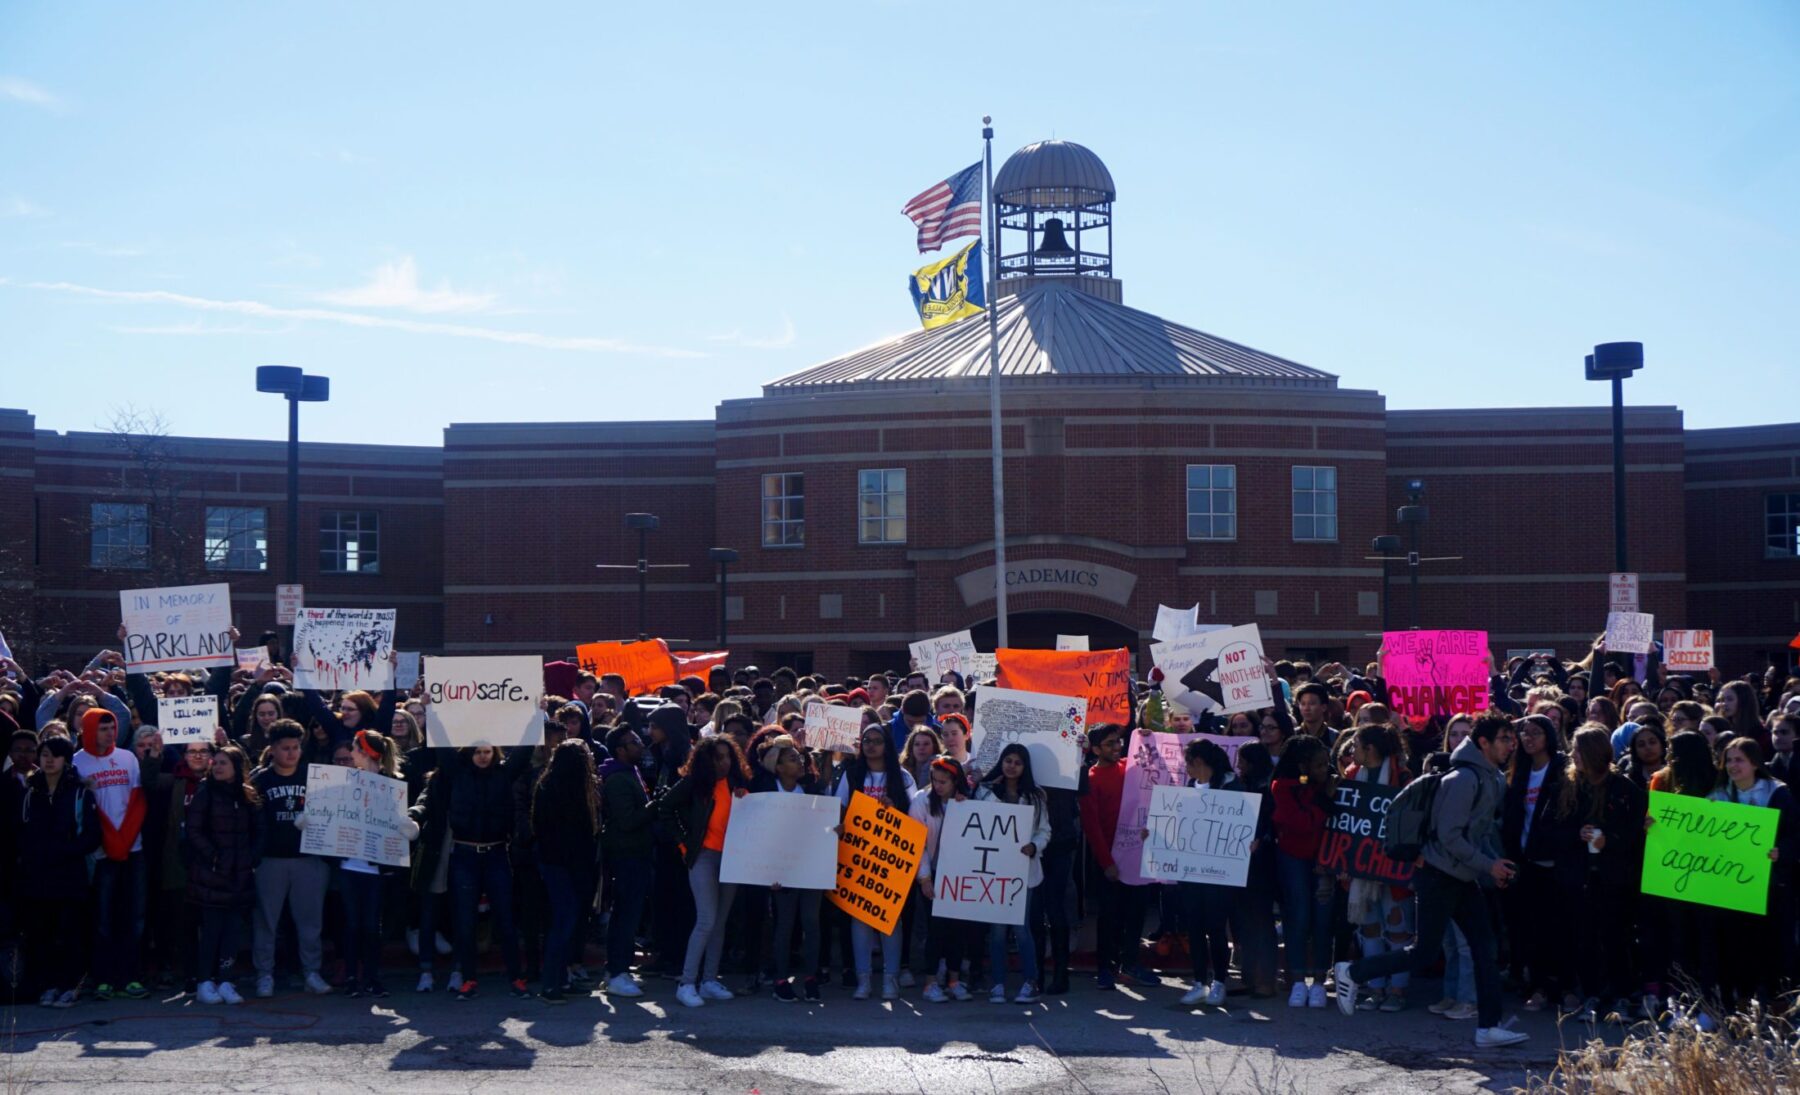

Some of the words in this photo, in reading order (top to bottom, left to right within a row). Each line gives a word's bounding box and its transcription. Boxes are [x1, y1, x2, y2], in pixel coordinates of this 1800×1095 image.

[993, 568, 1098, 588] CADEMICS
[134, 596, 149, 611] IN
[159, 593, 215, 609] MEMORY
[166, 614, 183, 625] OF
[127, 631, 232, 662] PARKLAND
[1386, 633, 1418, 657] WE
[1436, 631, 1480, 656] ARE
[1225, 649, 1247, 665] NOT
[1083, 668, 1129, 687] VICTIMS
[1220, 664, 1263, 686] ANOTHER
[430, 678, 530, 704] g(un)safe.
[1076, 690, 1130, 713] HANGE
[1231, 686, 1253, 701] ONE
[1387, 684, 1487, 716] CHANGE
[809, 704, 832, 720] MY
[167, 727, 179, 737] TO
[309, 765, 330, 781] In
[346, 769, 405, 801] Memory
[1161, 792, 1184, 812] We
[1197, 793, 1245, 816] Stand
[1334, 787, 1361, 808] It
[306, 801, 333, 824] Sandy
[336, 804, 361, 820] Hook
[876, 808, 902, 829] GUN
[853, 815, 915, 855] CONTROL
[961, 812, 1020, 843] AM
[1149, 815, 1254, 857] TOGETHER
[1659, 805, 1762, 847] #never
[869, 845, 913, 873] ABOUT
[971, 846, 999, 875] I
[1148, 854, 1161, 872] to
[1162, 858, 1179, 873] end
[1318, 831, 1353, 873] UR
[1661, 847, 1754, 893] again
[856, 874, 902, 904] ABOUT
[940, 876, 1024, 907] NEXT?
